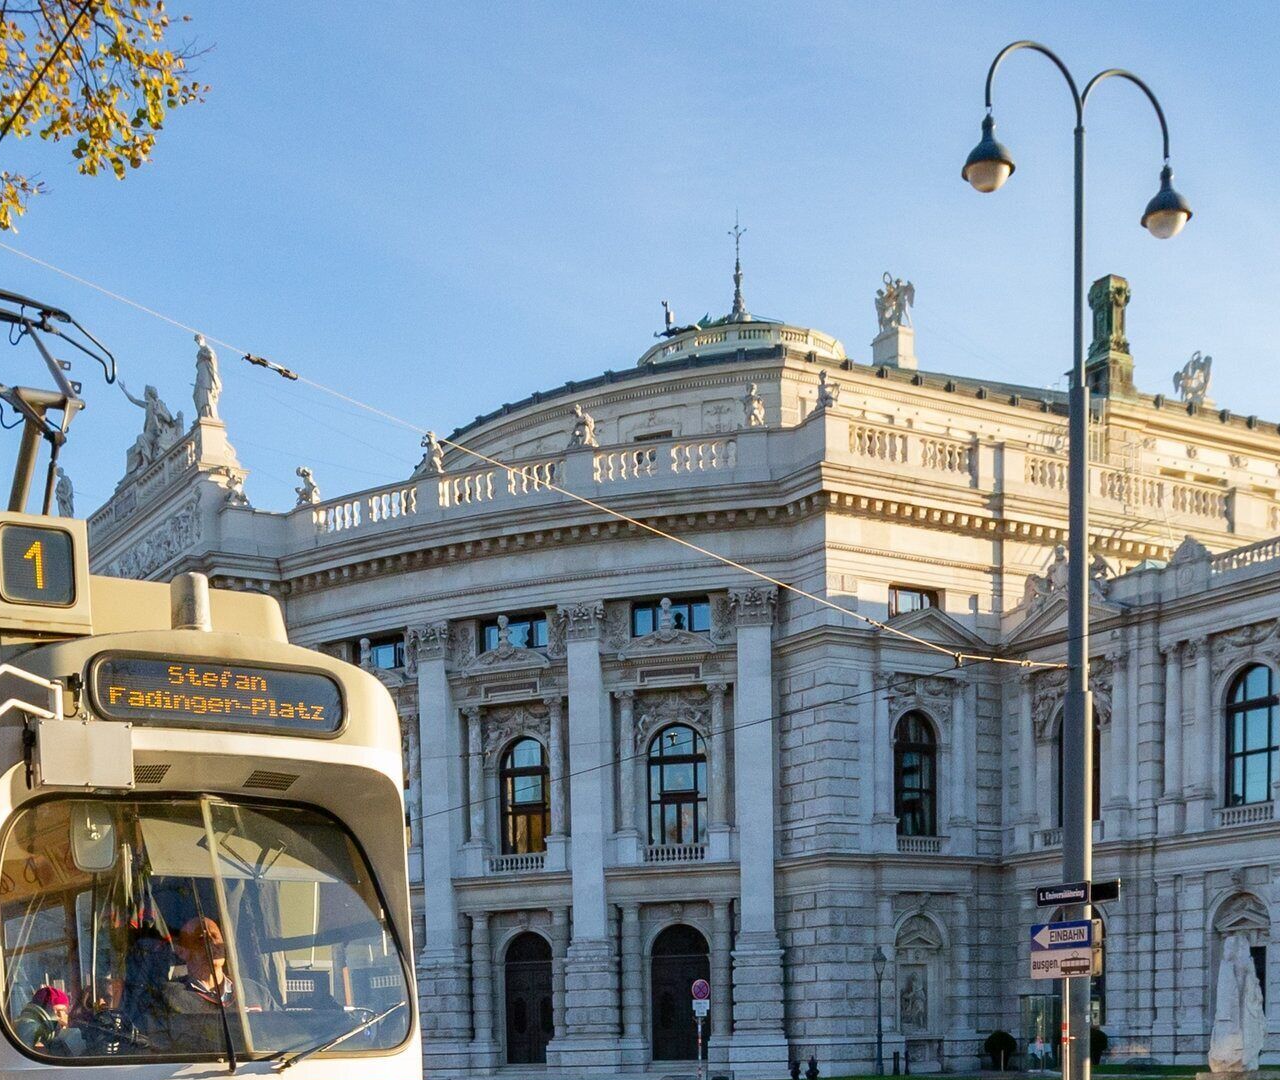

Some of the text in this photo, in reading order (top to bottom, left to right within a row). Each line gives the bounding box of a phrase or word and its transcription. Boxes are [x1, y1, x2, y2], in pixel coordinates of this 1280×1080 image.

[23, 541, 44, 590] 1
[168, 665, 267, 692] Stefan
[109, 686, 325, 721] Fadinger-Platz
[1050, 929, 1085, 942] EINBAHN
[1032, 959, 1059, 972] ausgen.
